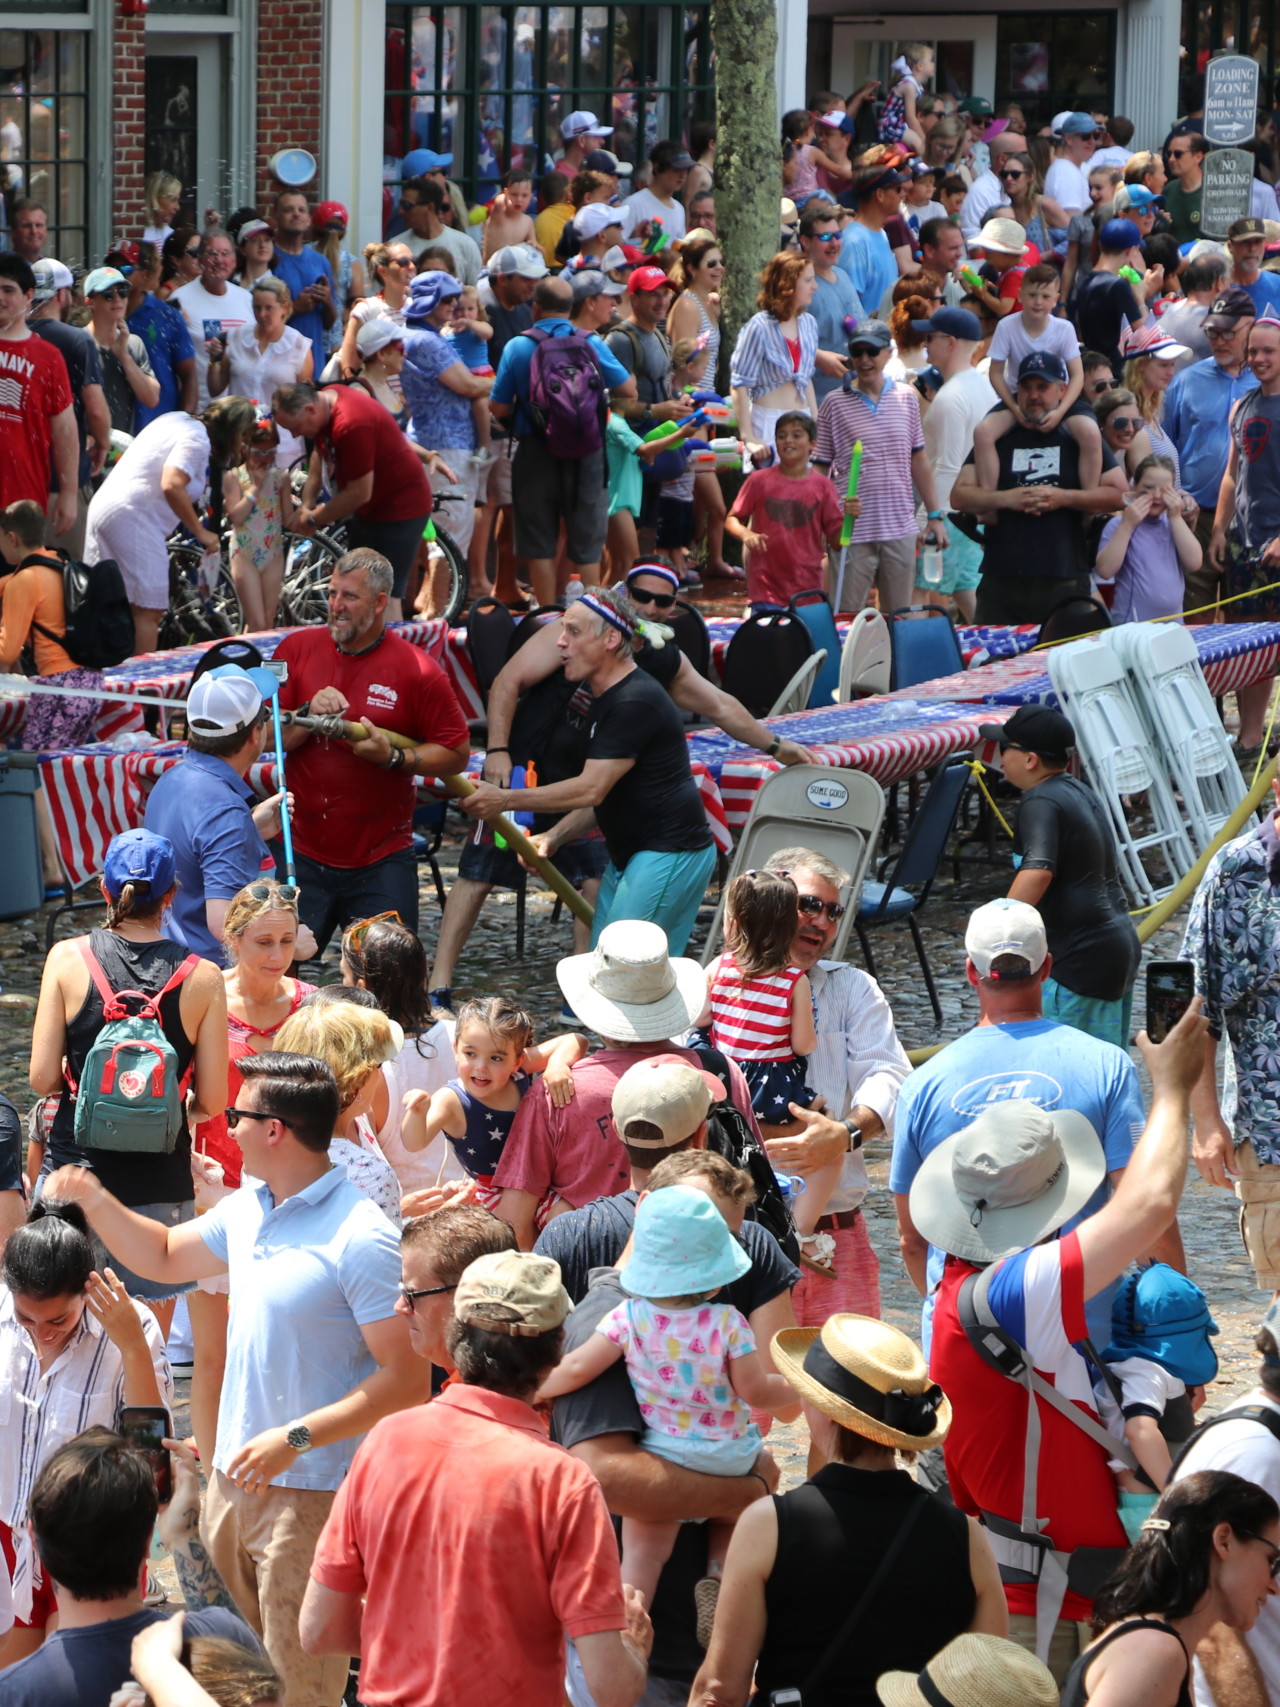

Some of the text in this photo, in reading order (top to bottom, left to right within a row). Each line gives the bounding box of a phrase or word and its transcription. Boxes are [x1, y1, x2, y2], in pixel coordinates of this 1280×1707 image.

[1212, 69, 1254, 80] LOADING
[1214, 82, 1250, 93] ZONE
[1236, 110, 1254, 119] SAT
[1222, 160, 1236, 171] NO
[1207, 173, 1250, 185] PARKING
[986, 1079, 1031, 1101] FT
